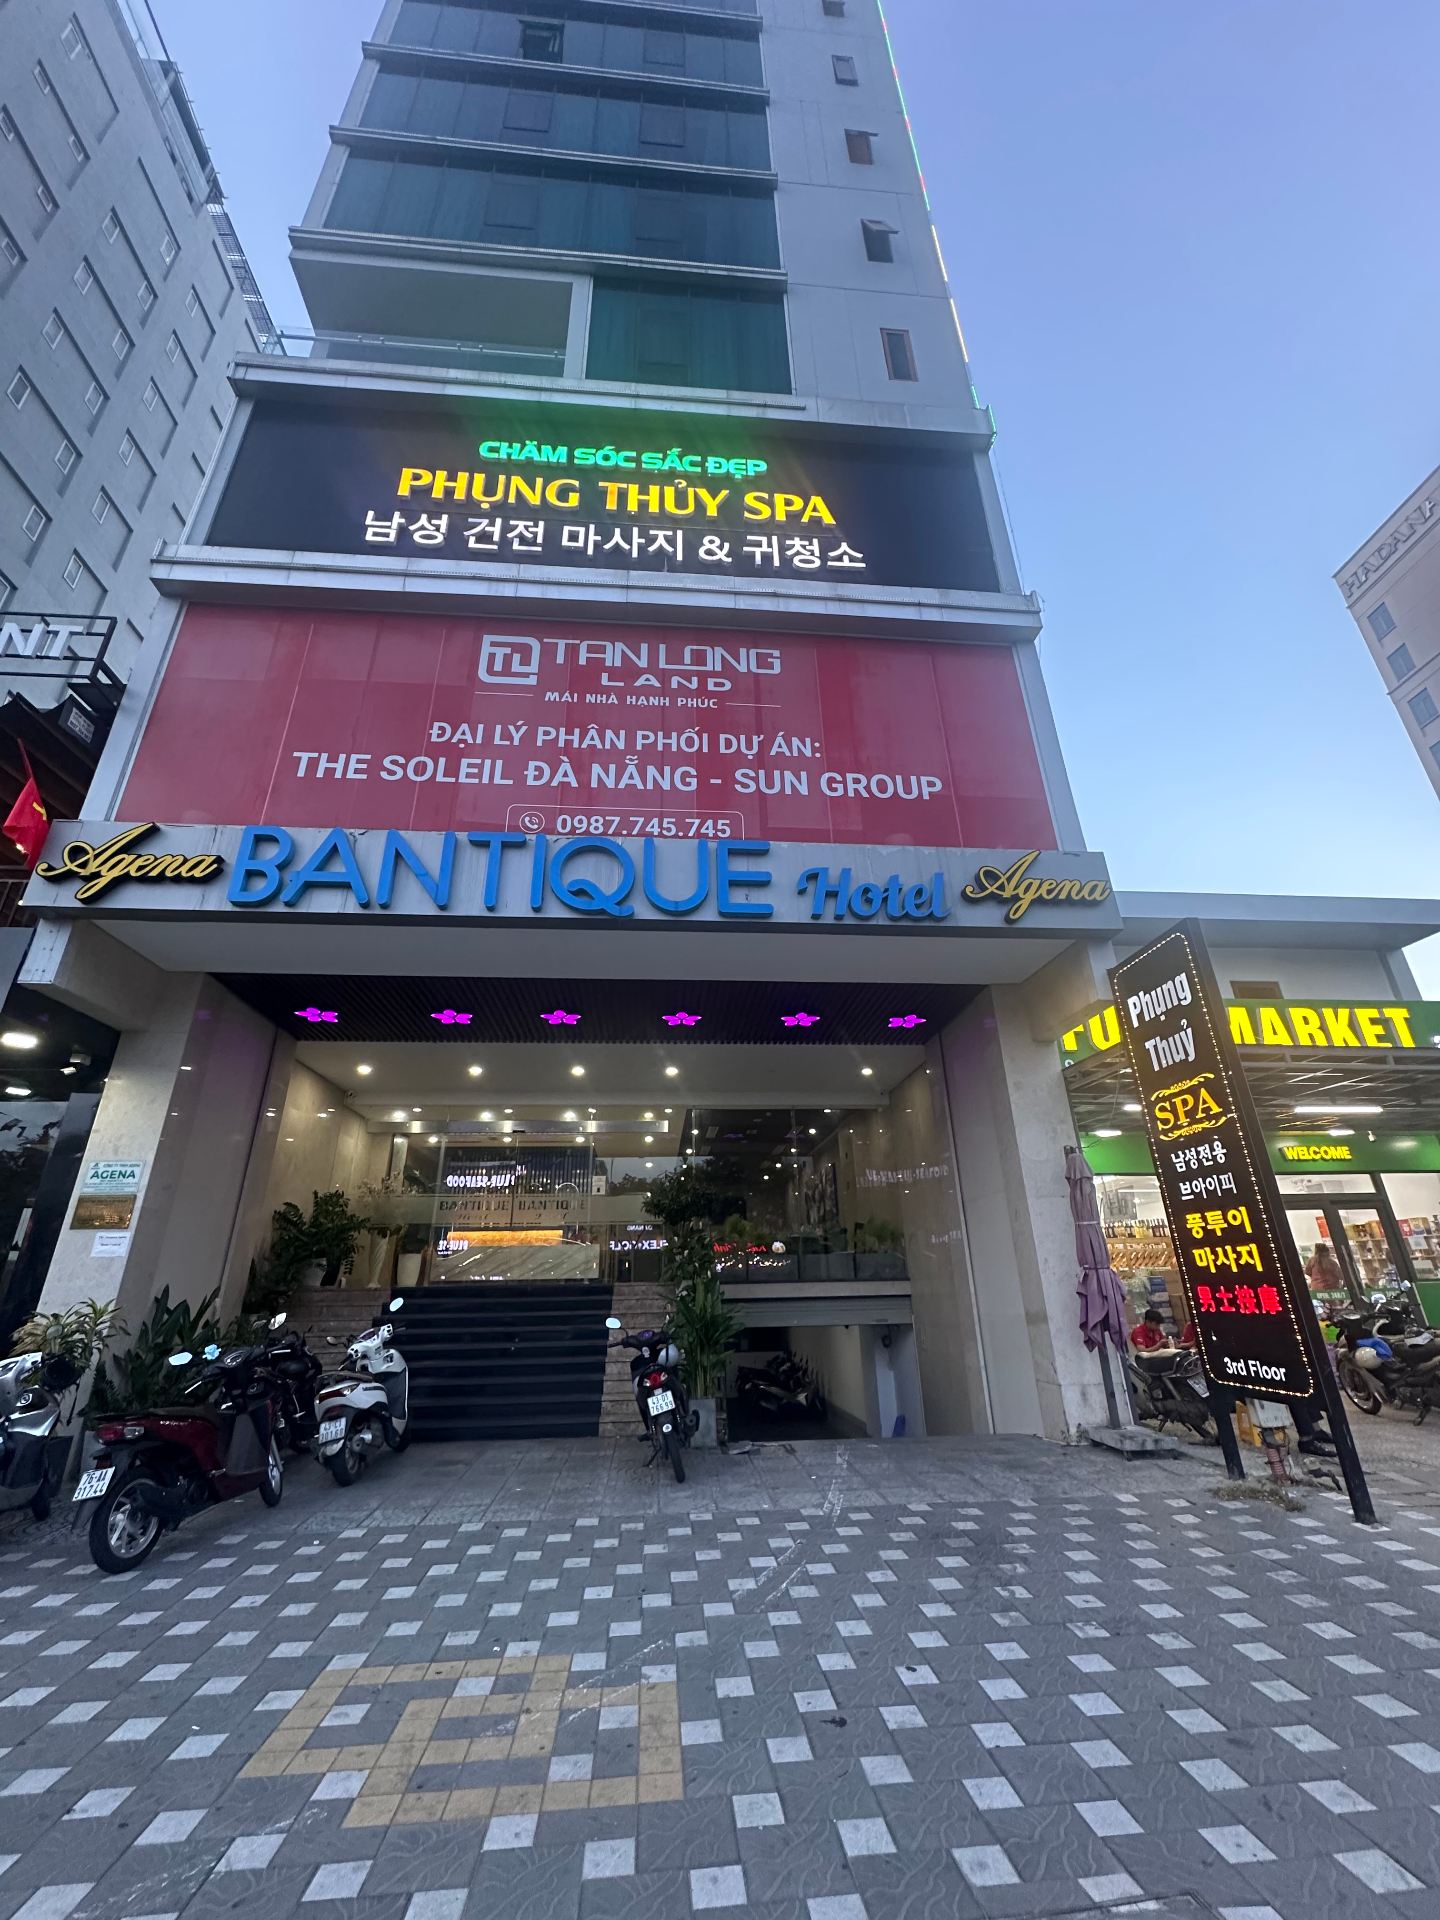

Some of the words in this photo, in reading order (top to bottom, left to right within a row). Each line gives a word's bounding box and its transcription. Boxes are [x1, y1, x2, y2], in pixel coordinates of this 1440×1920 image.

[479, 440, 568, 463] CHĂM
[573, 445, 636, 469] SÓC
[641, 448, 702, 473] SẮC
[705, 456, 768, 479] ĐẸP
[396, 467, 580, 510] PHỤNG
[598, 479, 730, 519] THỦY
[743, 491, 837, 526] SPA
[364, 510, 449, 548] 남성
[463, 517, 545, 554] 건전
[561, 523, 683, 562] 마사지
[698, 535, 733, 565] &
[742, 534, 867, 571] 귀청소
[544, 690, 578, 703] MÁI
[585, 691, 619, 704] NHÀ
[626, 694, 670, 708] HẠNH
[677, 695, 719, 709] PHÚC
[601, 672, 732, 691] LAND
[429, 721, 484, 748] ĐẠI
[493, 720, 529, 746] LÝ
[536, 723, 626, 750] PHÂN
[636, 726, 709, 753] PHỐI
[719, 732, 765, 759] DỰ
[769, 731, 822, 758] ÁN:
[292, 751, 372, 780] THE
[379, 755, 514, 785] SOLEIL
[523, 755, 579, 788] ĐÀ
[590, 754, 698, 792] NẴNG
[734, 768, 809, 796] SUN
[820, 772, 943, 800] GROUP
[556, 814, 732, 838] 0987.745.745
[36, 822, 226, 904] Agena
[226, 824, 775, 919] BANTIQUE
[796, 866, 952, 921] Hotel
[961, 850, 1114, 925] Agena
[1127, 972, 1192, 1028] Phụng
[1145, 1018, 1196, 1072] Thuỷ
[1154, 1087, 1223, 1131] SPA
[1171, 1140, 1227, 1173] 남성전용
[1283, 1145, 1353, 1160] WELCOME
[90, 1170, 136, 1179] AGENA
[1179, 1172, 1237, 1201] 브아이피
[1185, 1206, 1253, 1240] 풍투이
[1192, 1243, 1263, 1274] 마사지
[1197, 1284, 1283, 1315] 男士按摩
[1223, 1356, 1247, 1377] 3rd
[1248, 1360, 1287, 1382] Floor
